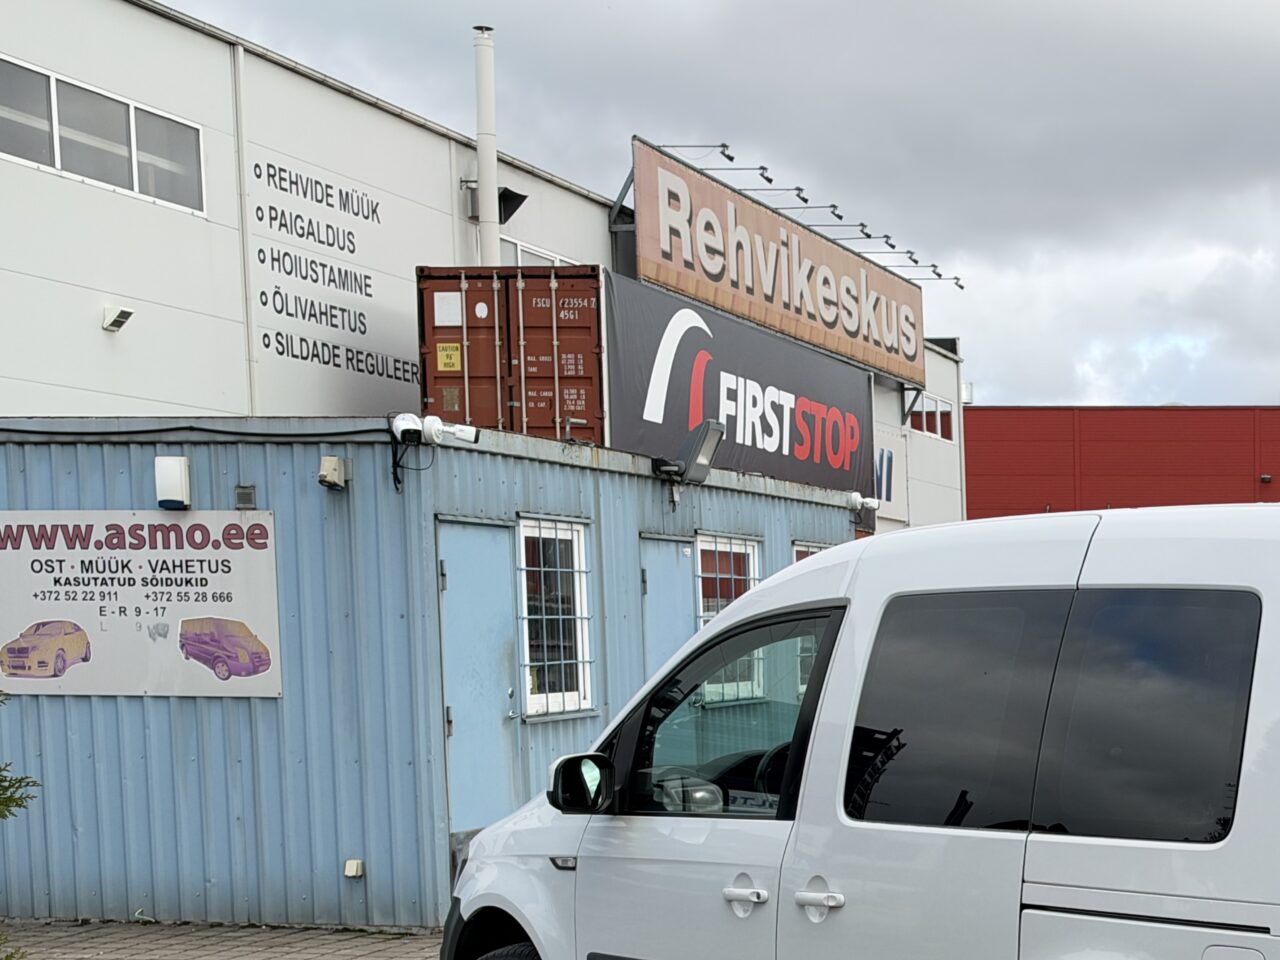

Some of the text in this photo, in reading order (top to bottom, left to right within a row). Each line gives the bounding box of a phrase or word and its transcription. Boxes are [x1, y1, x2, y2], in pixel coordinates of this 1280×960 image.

[266, 162, 381, 224] REHVIDE MÜÜK
[268, 205, 356, 254] PAIGALDUS
[270, 247, 373, 298] HOIUSTAMINE
[656, 166, 917, 359] Rehvikeskus
[272, 285, 367, 335] ÕLIVAHETUS
[532, 298, 550, 308] FSCU
[275, 331, 341, 368] SILDADE
[0, 523, 268, 550] www.asmo.ee
[30, 557, 232, 574] OST MÜÜK VAHETUS
[53, 575, 209, 587] KASUTATUD SÕIDUKID
[32, 591, 118, 601] +372 52 22 911
[144, 592, 233, 602] +372 55 28 666
[99, 606, 107, 617] E
[119, 606, 128, 617] R
[134, 606, 142, 617] 9
[153, 607, 167, 617] 17
